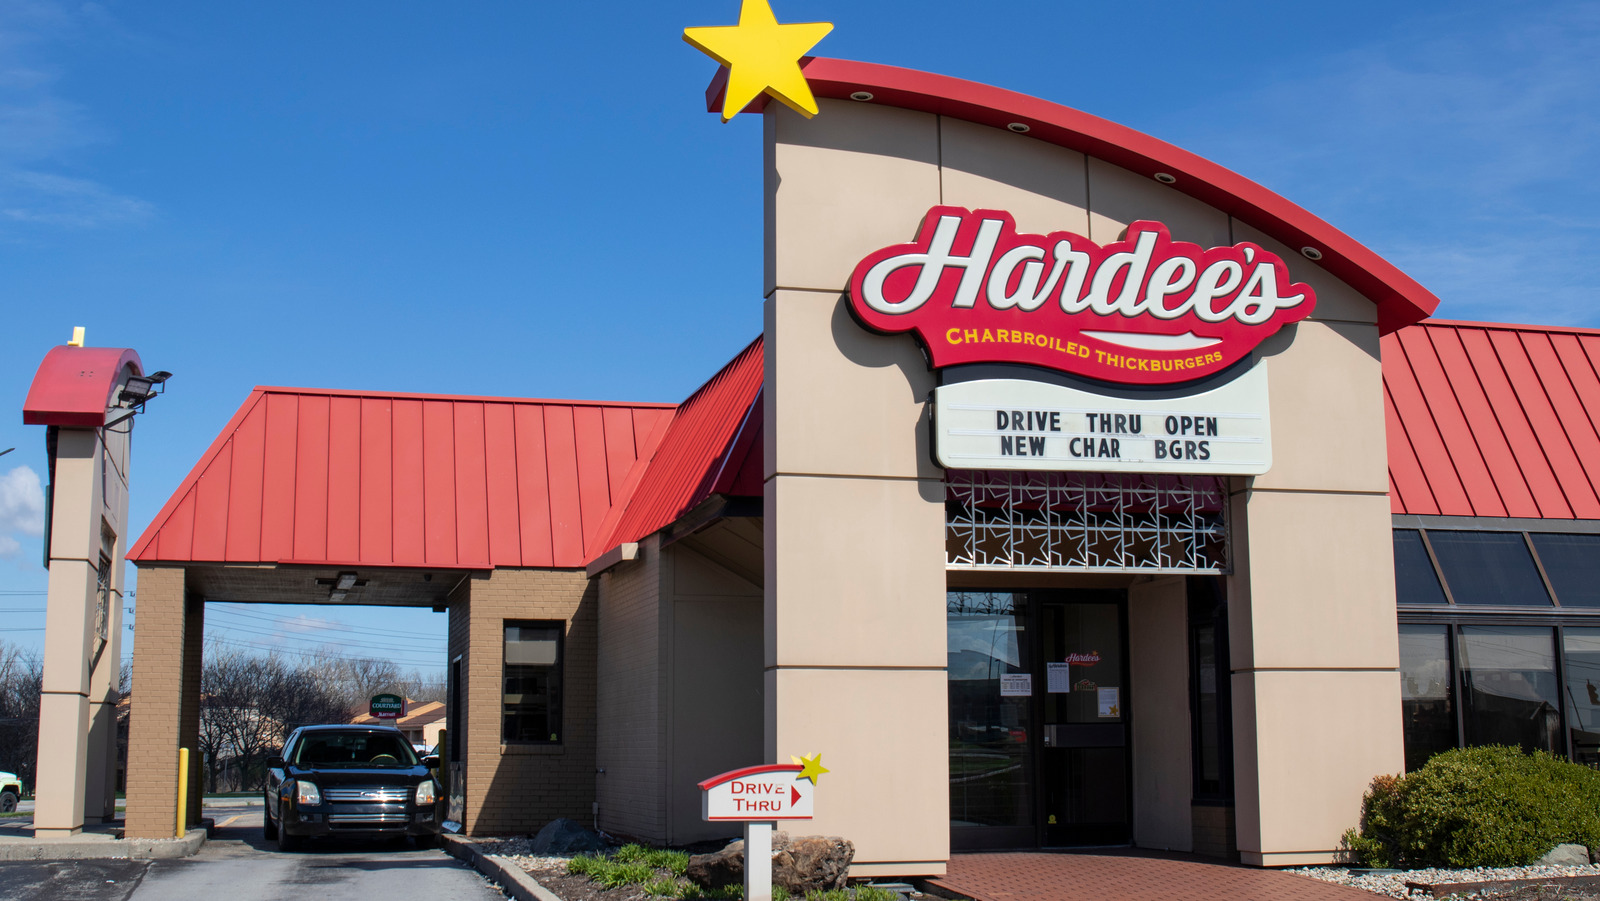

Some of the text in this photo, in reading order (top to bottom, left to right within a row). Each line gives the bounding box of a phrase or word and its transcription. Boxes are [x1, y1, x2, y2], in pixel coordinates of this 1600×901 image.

[861, 215, 1305, 324] Hardee's
[946, 327, 1223, 371] CHARBROILED THICKBURGERS
[996, 410, 1218, 436] DRIVE THRU OPEN
[1001, 435, 1211, 460] NEW CHAR BGRS
[733, 798, 781, 811] THRU
